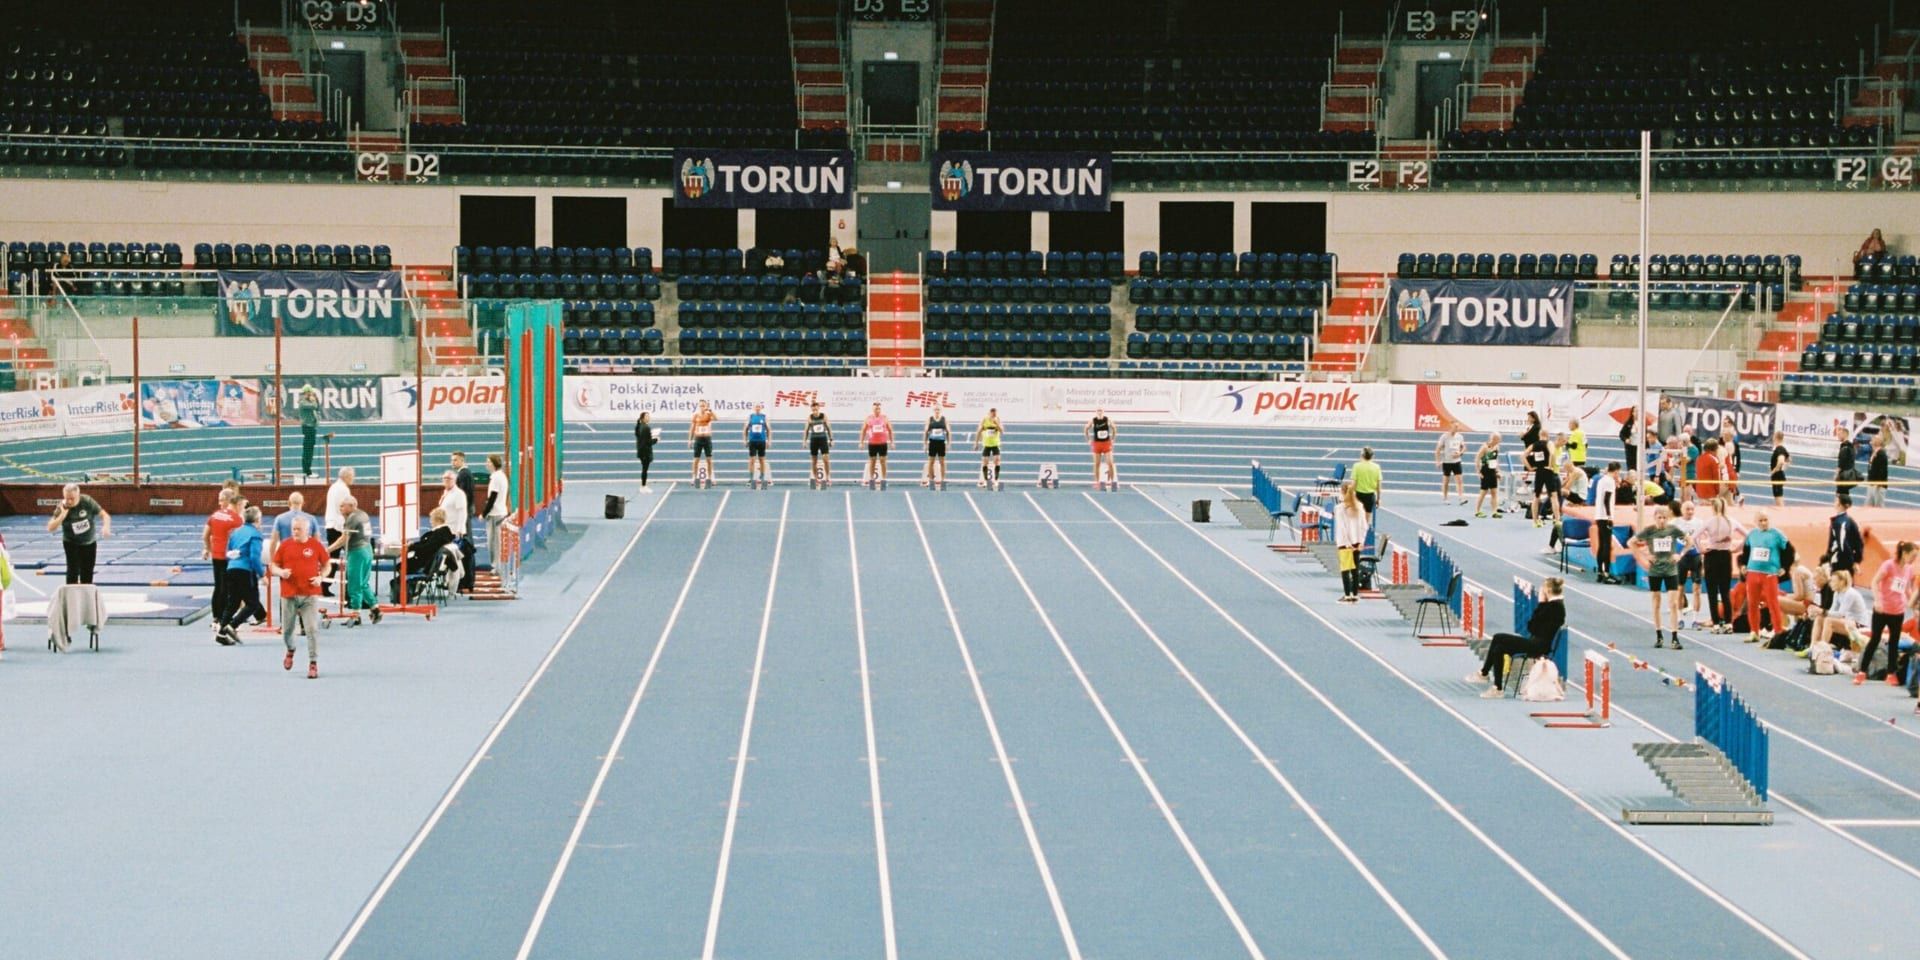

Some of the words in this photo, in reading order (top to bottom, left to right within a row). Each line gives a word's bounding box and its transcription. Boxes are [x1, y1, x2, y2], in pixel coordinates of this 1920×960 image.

[303, 1, 333, 21] C3
[346, 2, 376, 23] D3
[1407, 11, 1435, 31] E3
[1451, 10, 1478, 31] F3
[357, 152, 388, 176] C2
[406, 154, 438, 176] D2
[1350, 161, 1379, 183] E2
[1399, 162, 1427, 183] F2
[1837, 157, 1866, 181] F2
[1882, 157, 1912, 181] G2
[718, 157, 844, 194] TORUŃ
[976, 159, 1102, 196] TORUŃ
[264, 279, 392, 319] TORUŃ
[1433, 287, 1564, 328] TORUŃ
[610, 383, 648, 394] Polski
[651, 383, 704, 397] Związek
[906, 391, 957, 408] MKL
[67, 401, 119, 416] InterRisk
[610, 400, 656, 412] Lekkiej
[659, 400, 710, 412] Atletyi
[714, 400, 765, 411] Mastes
[1253, 387, 1359, 415] polanik
[1781, 420, 1832, 436] InterRisk
[699, 467, 707, 480] 8
[816, 467, 824, 480] 6
[1044, 468, 1053, 480] 2
